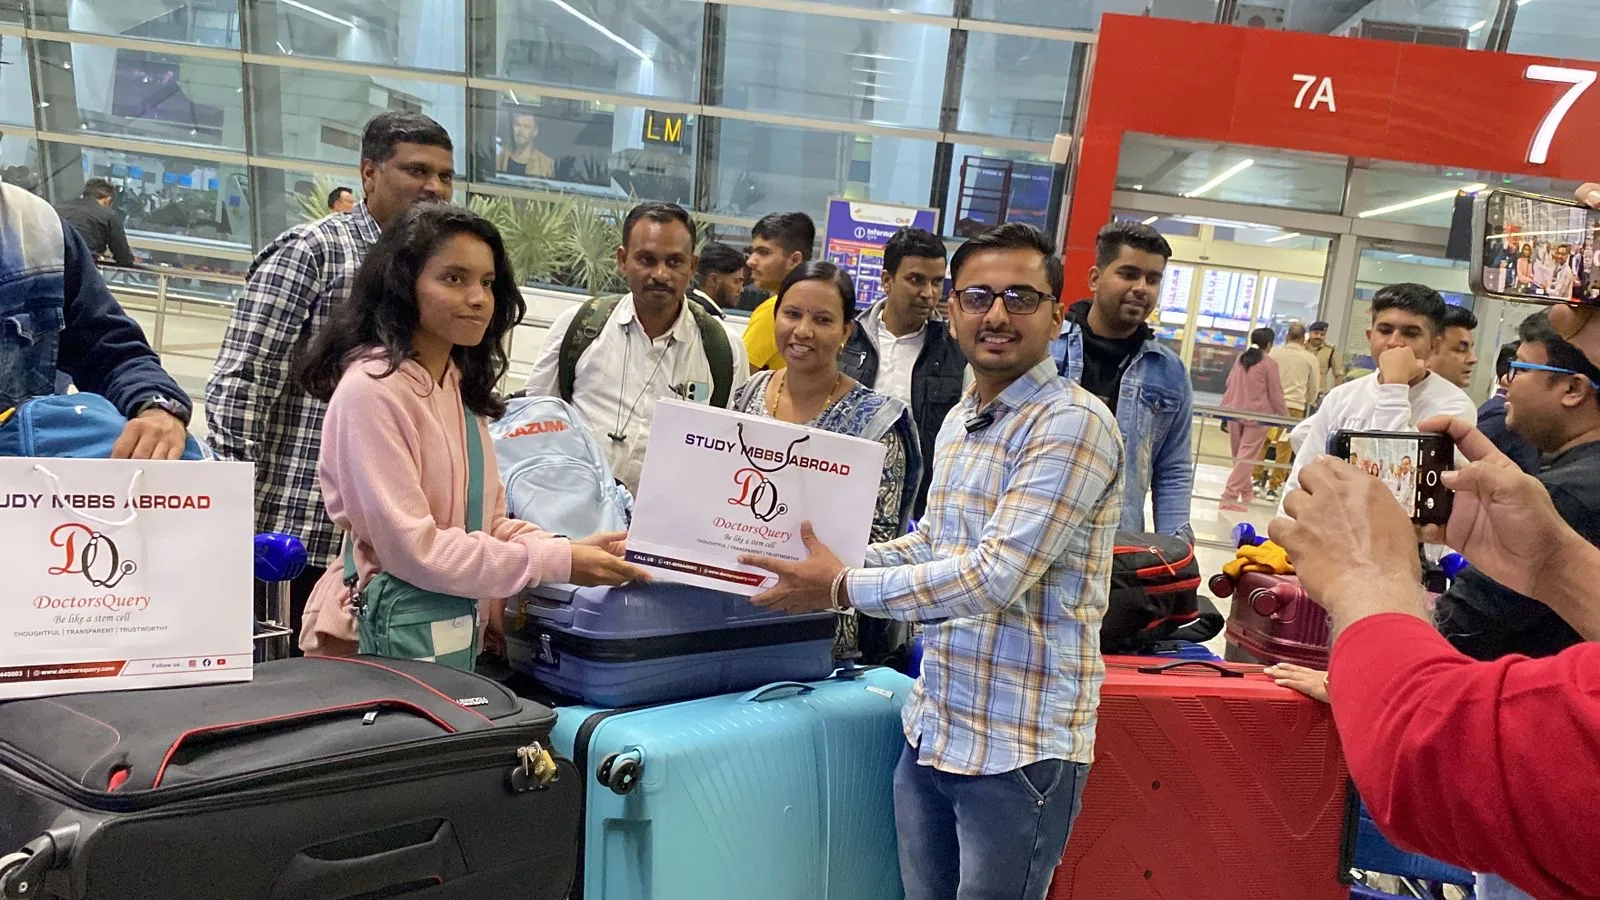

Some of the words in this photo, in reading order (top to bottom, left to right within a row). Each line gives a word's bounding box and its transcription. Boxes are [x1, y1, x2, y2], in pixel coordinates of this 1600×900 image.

[1292, 73, 1337, 113] 7A
[1525, 64, 1598, 165] 7
[685, 433, 736, 453] STUDY
[741, 445, 784, 463] MBBS
[788, 455, 850, 476] ABROAD
[52, 494, 115, 509] MBBS
[123, 495, 211, 509] ABROAD
[713, 516, 793, 543] DoctorsQuery
[734, 534, 745, 543] like
[750, 539, 764, 547] stem
[764, 541, 777, 549] cell
[730, 545, 763, 555] TRANSPARENT
[765, 551, 800, 561] TRUSTWORTHY
[33, 593, 151, 612] DoctorsQuery
[53, 615, 66, 625] Be
[68, 613, 84, 625] like
[94, 614, 114, 623] stem
[115, 612, 132, 622] cell
[13, 629, 61, 638] THOUGHTFUL
[66, 627, 114, 635] TRANSPARENT
[119, 626, 169, 634] TRUSTWORTHY
